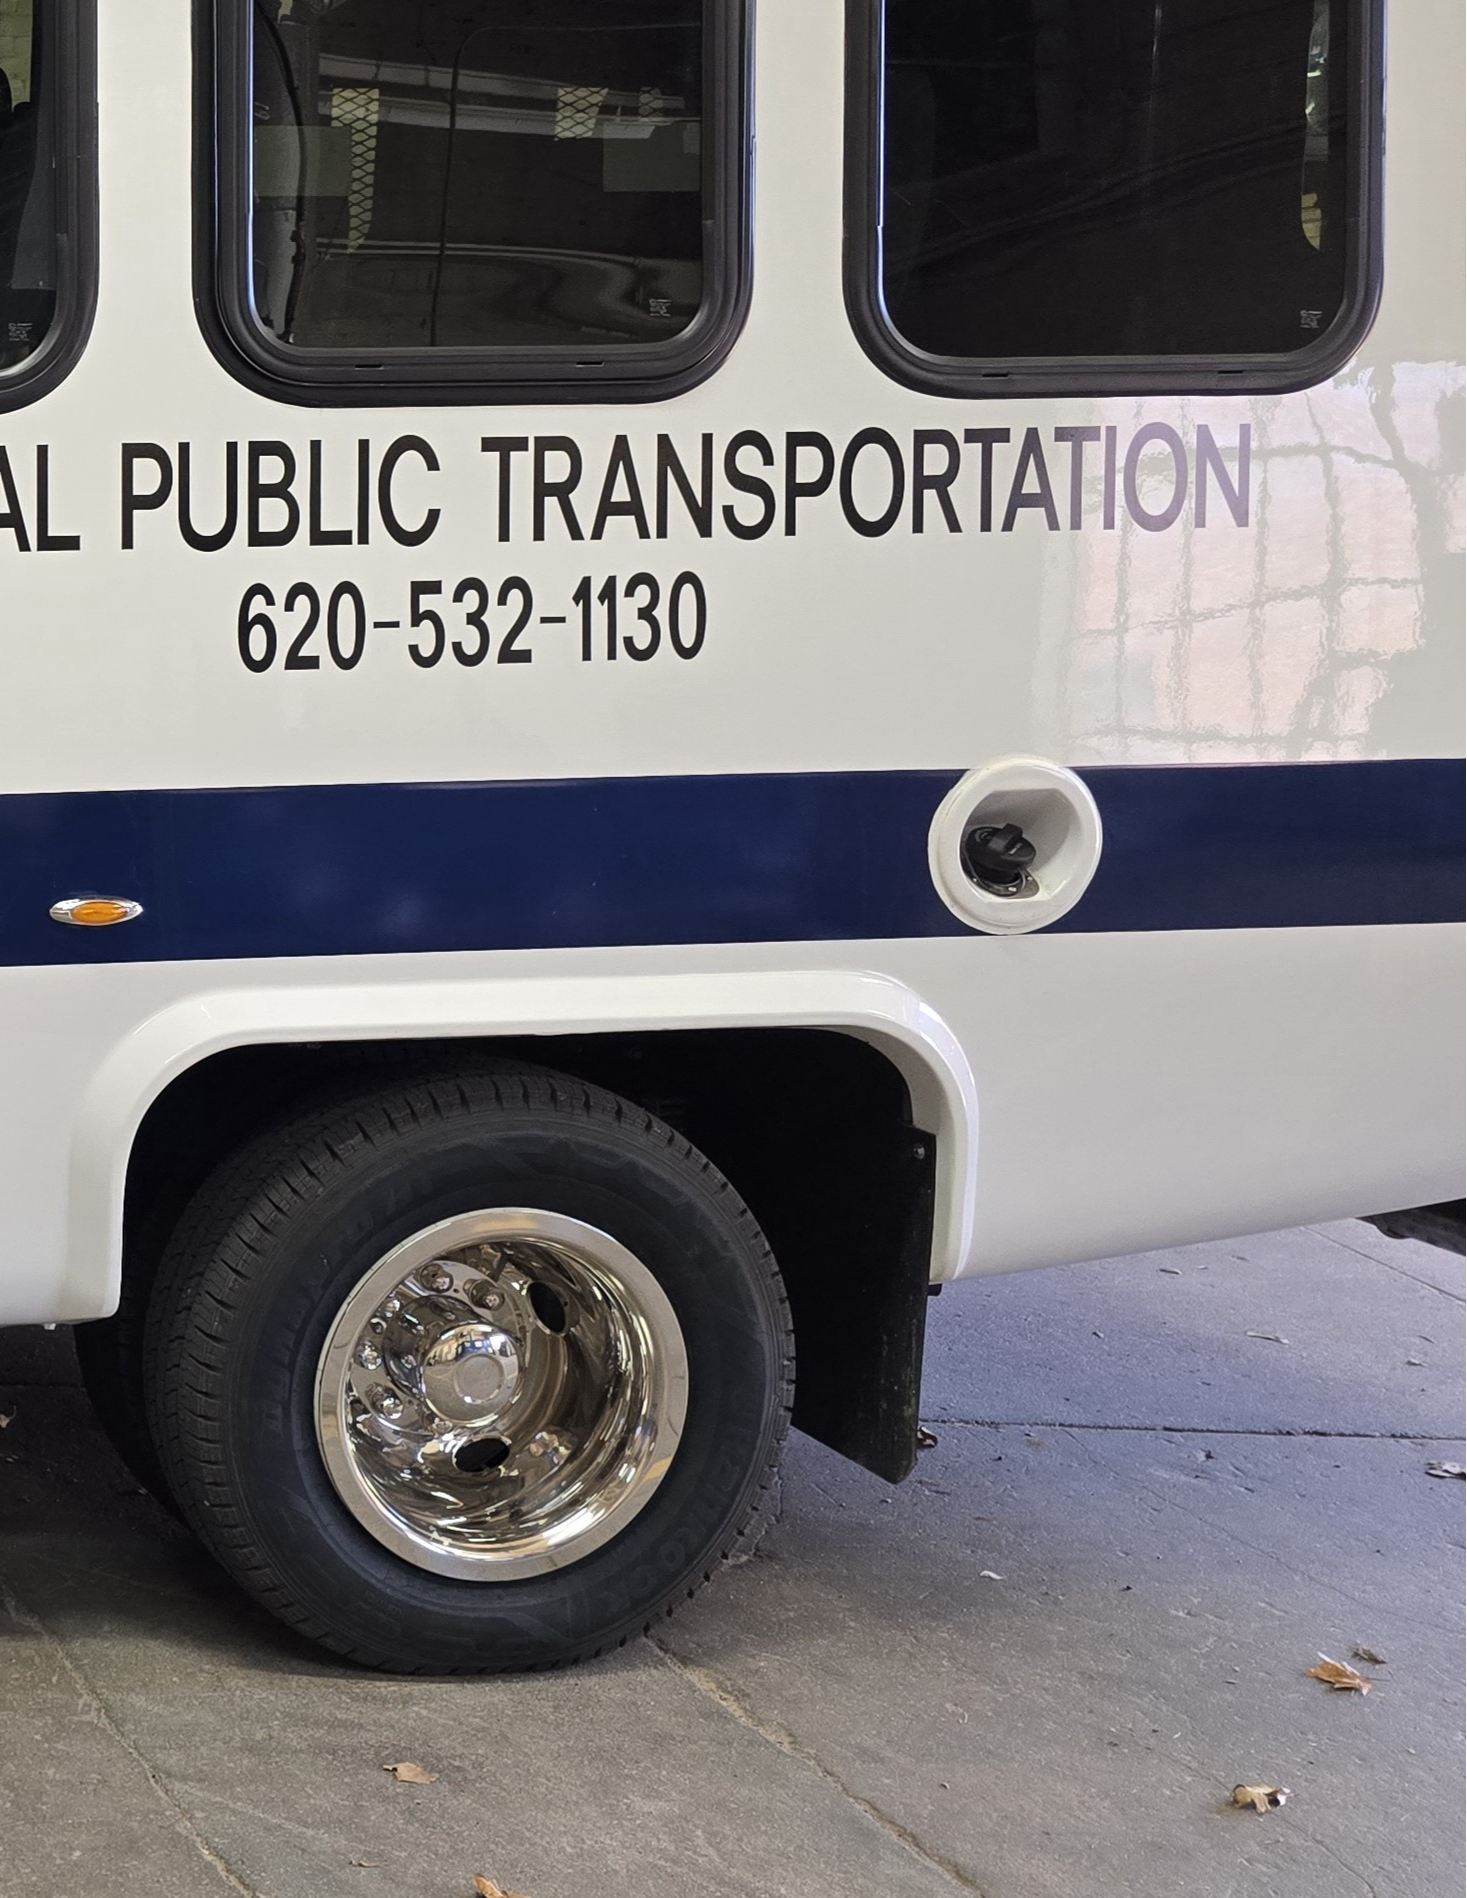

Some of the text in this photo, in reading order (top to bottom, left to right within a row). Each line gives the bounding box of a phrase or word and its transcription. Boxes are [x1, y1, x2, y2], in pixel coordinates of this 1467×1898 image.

[122, 435, 441, 552] PUBLIC
[480, 421, 1253, 543] TRANSPORTATION
[238, 571, 706, 673] 620-532-1130
